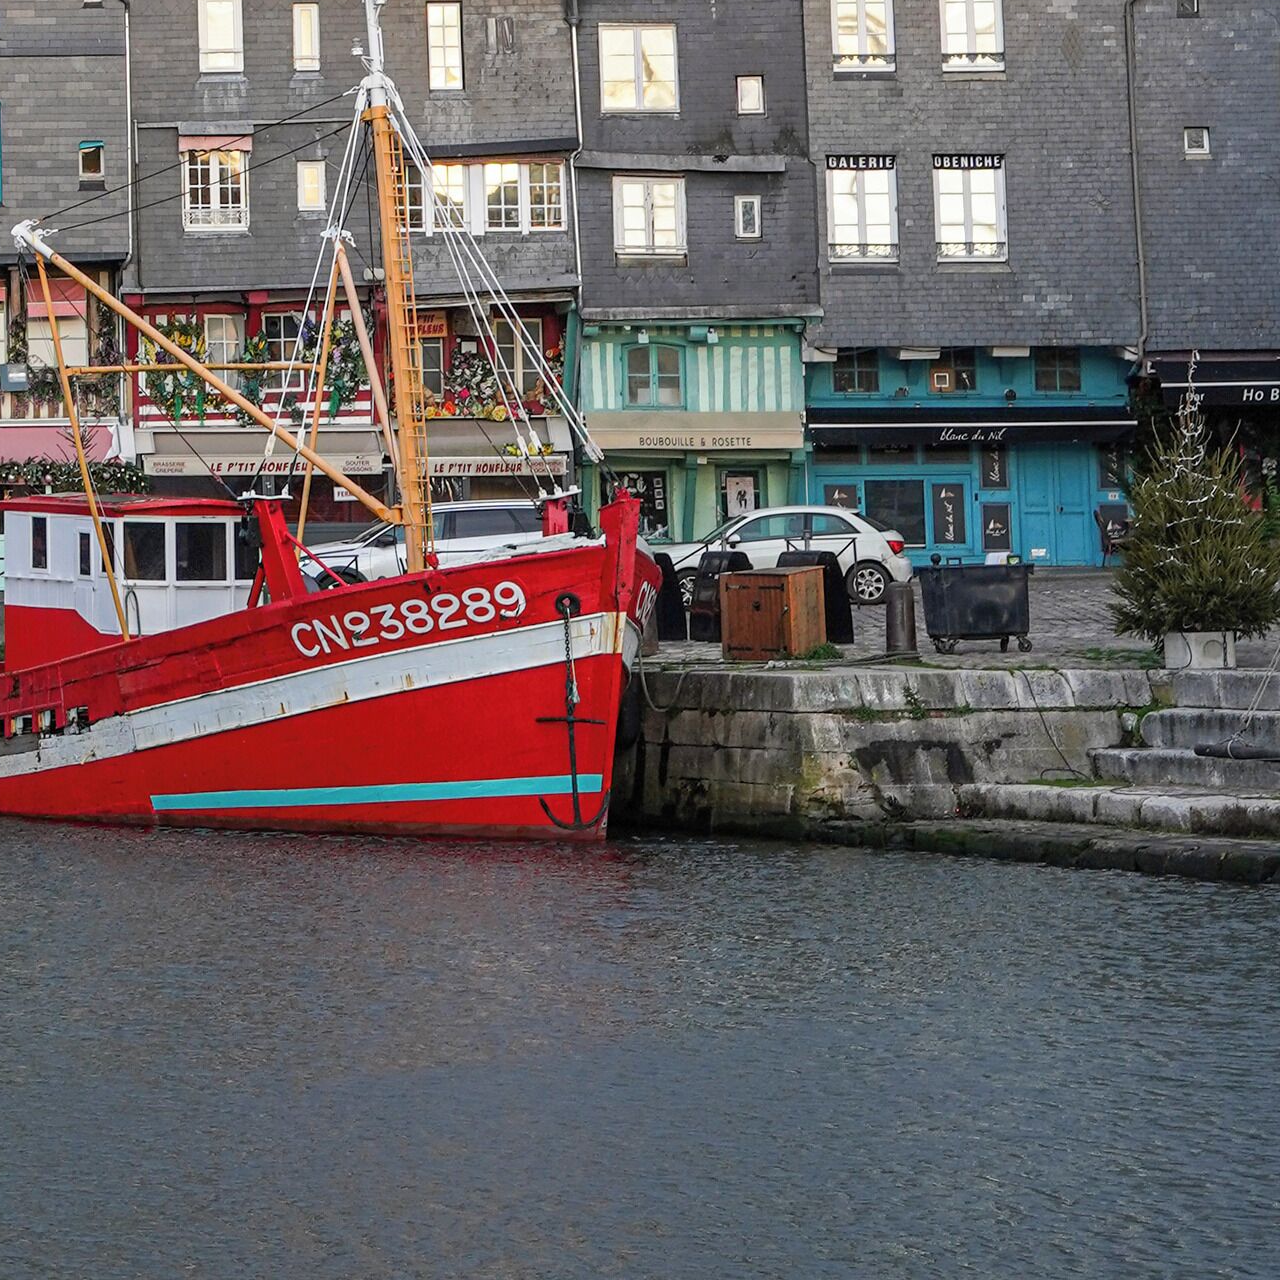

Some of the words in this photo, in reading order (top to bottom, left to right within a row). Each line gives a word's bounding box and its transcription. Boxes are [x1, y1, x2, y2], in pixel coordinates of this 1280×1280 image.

[828, 156, 893, 168] GALERIE
[934, 155, 1001, 168] OBENICHE
[1242, 388, 1264, 401] Ho
[940, 428, 969, 441] blanc
[971, 429, 985, 440] du
[639, 437, 694, 446] BOUBOUILLE
[712, 437, 752, 446] ROSETTE
[210, 463, 222, 472] LE
[227, 462, 256, 472] P'TIT
[260, 462, 315, 473] HONFEU
[434, 463, 444, 473] LE
[448, 463, 472, 473] P'TIT
[476, 463, 523, 473] HONFLEUR
[290, 580, 527, 658] CN238289
